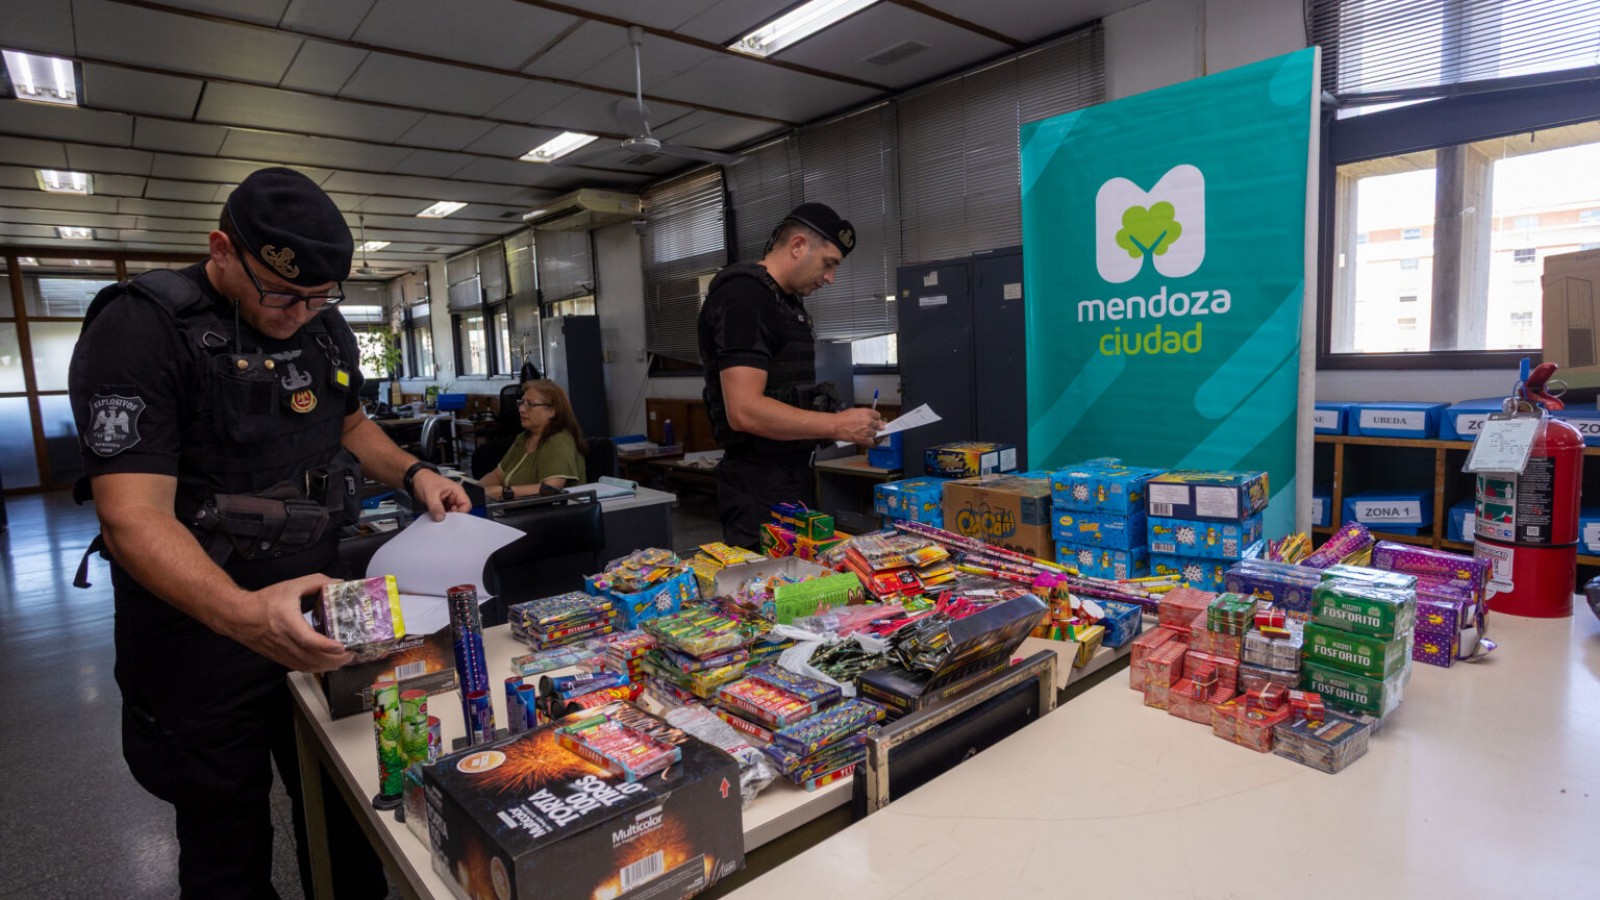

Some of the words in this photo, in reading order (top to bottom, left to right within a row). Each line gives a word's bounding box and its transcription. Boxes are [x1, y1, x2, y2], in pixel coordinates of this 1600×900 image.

[1078, 286, 1231, 322] mendoza
[1099, 322, 1203, 356] ciudad
[93, 398, 138, 411] EXPLOSIVOS
[1373, 416, 1407, 425] UBEDA
[1365, 507, 1400, 517] ZONA
[1403, 507, 1410, 516] 1
[1323, 606, 1380, 627] FOSFORITO
[1314, 644, 1370, 666] FOSFORITO
[1311, 681, 1368, 704] FOSFORITO
[574, 775, 625, 807] TIROS
[527, 788, 580, 827] TORTA
[565, 792, 600, 815] 100
[508, 806, 547, 839] Multicolor
[612, 814, 663, 843] Multicolor
